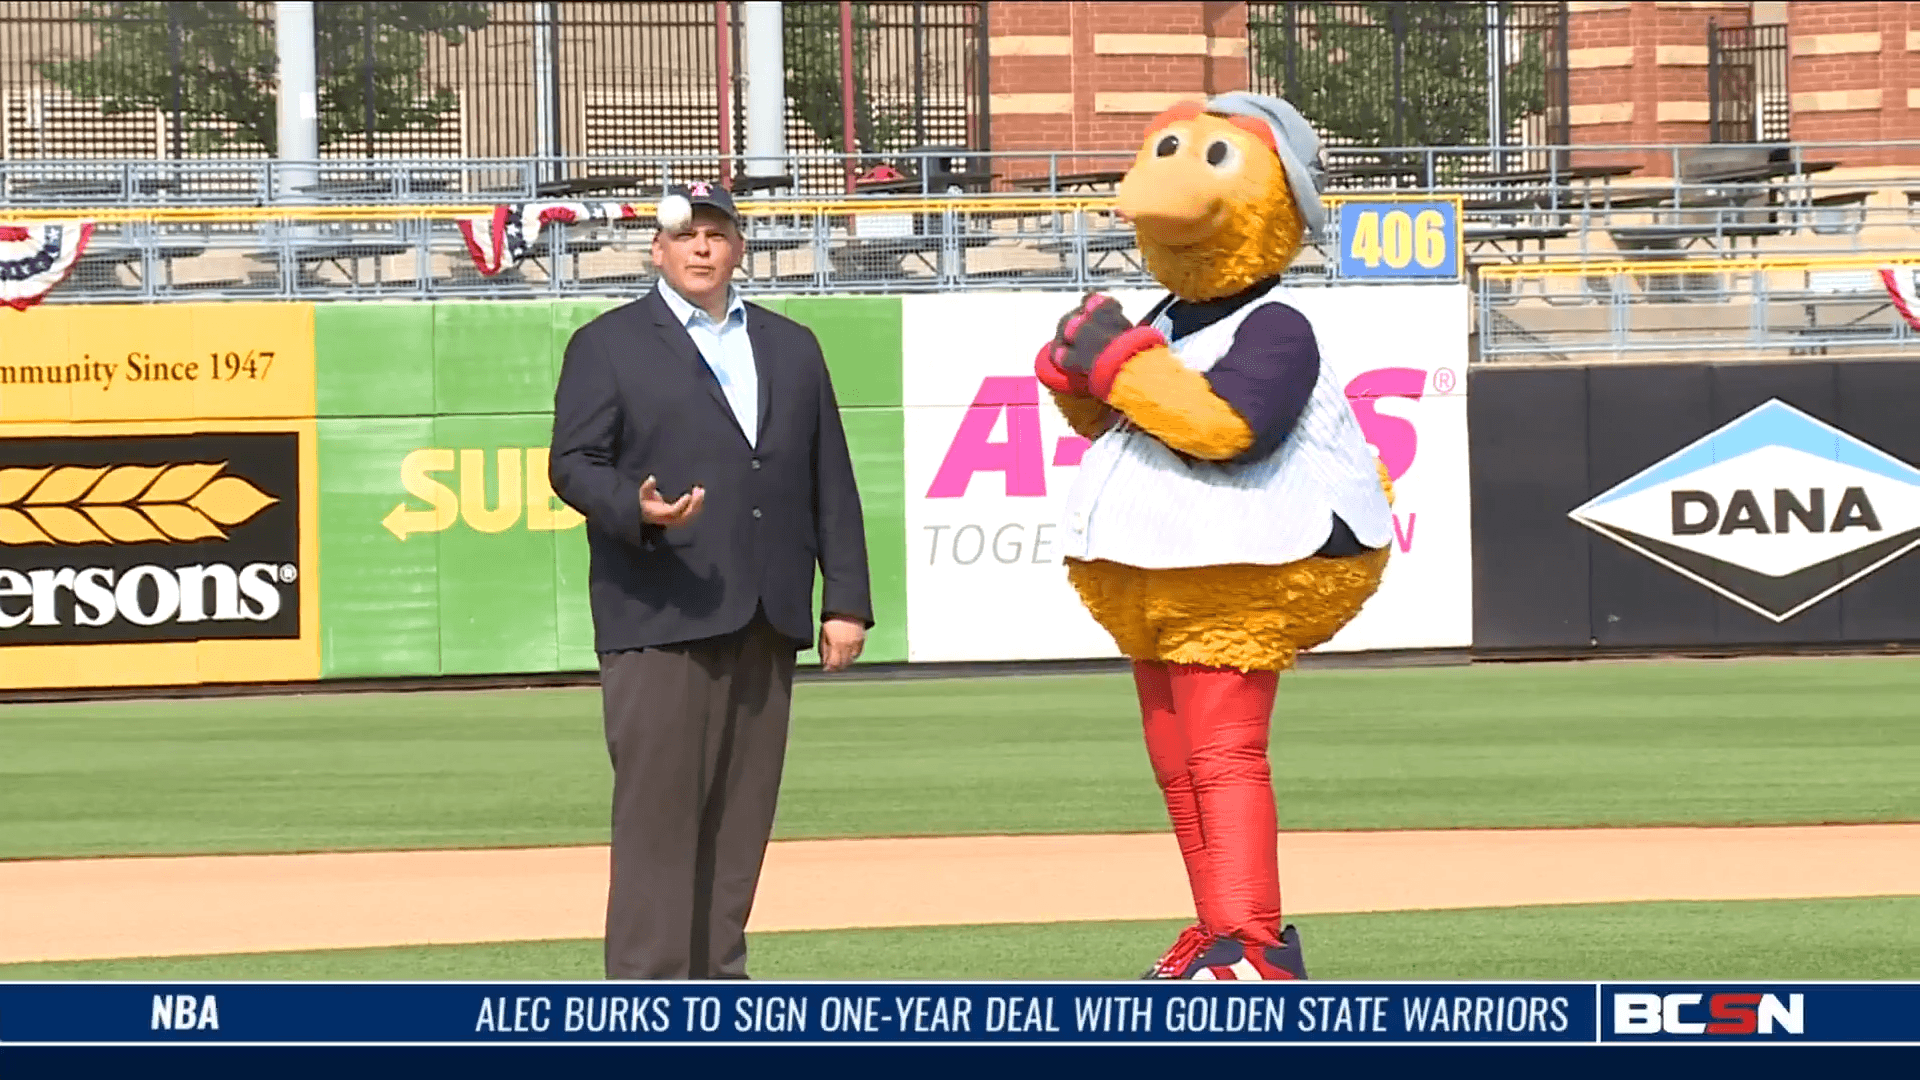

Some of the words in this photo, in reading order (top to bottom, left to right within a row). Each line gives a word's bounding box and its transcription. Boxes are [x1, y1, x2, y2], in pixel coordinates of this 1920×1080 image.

[1351, 210, 1447, 269] 406
[127, 352, 199, 382] Since
[211, 351, 276, 380] 1947
[1671, 486, 1883, 536] DANA
